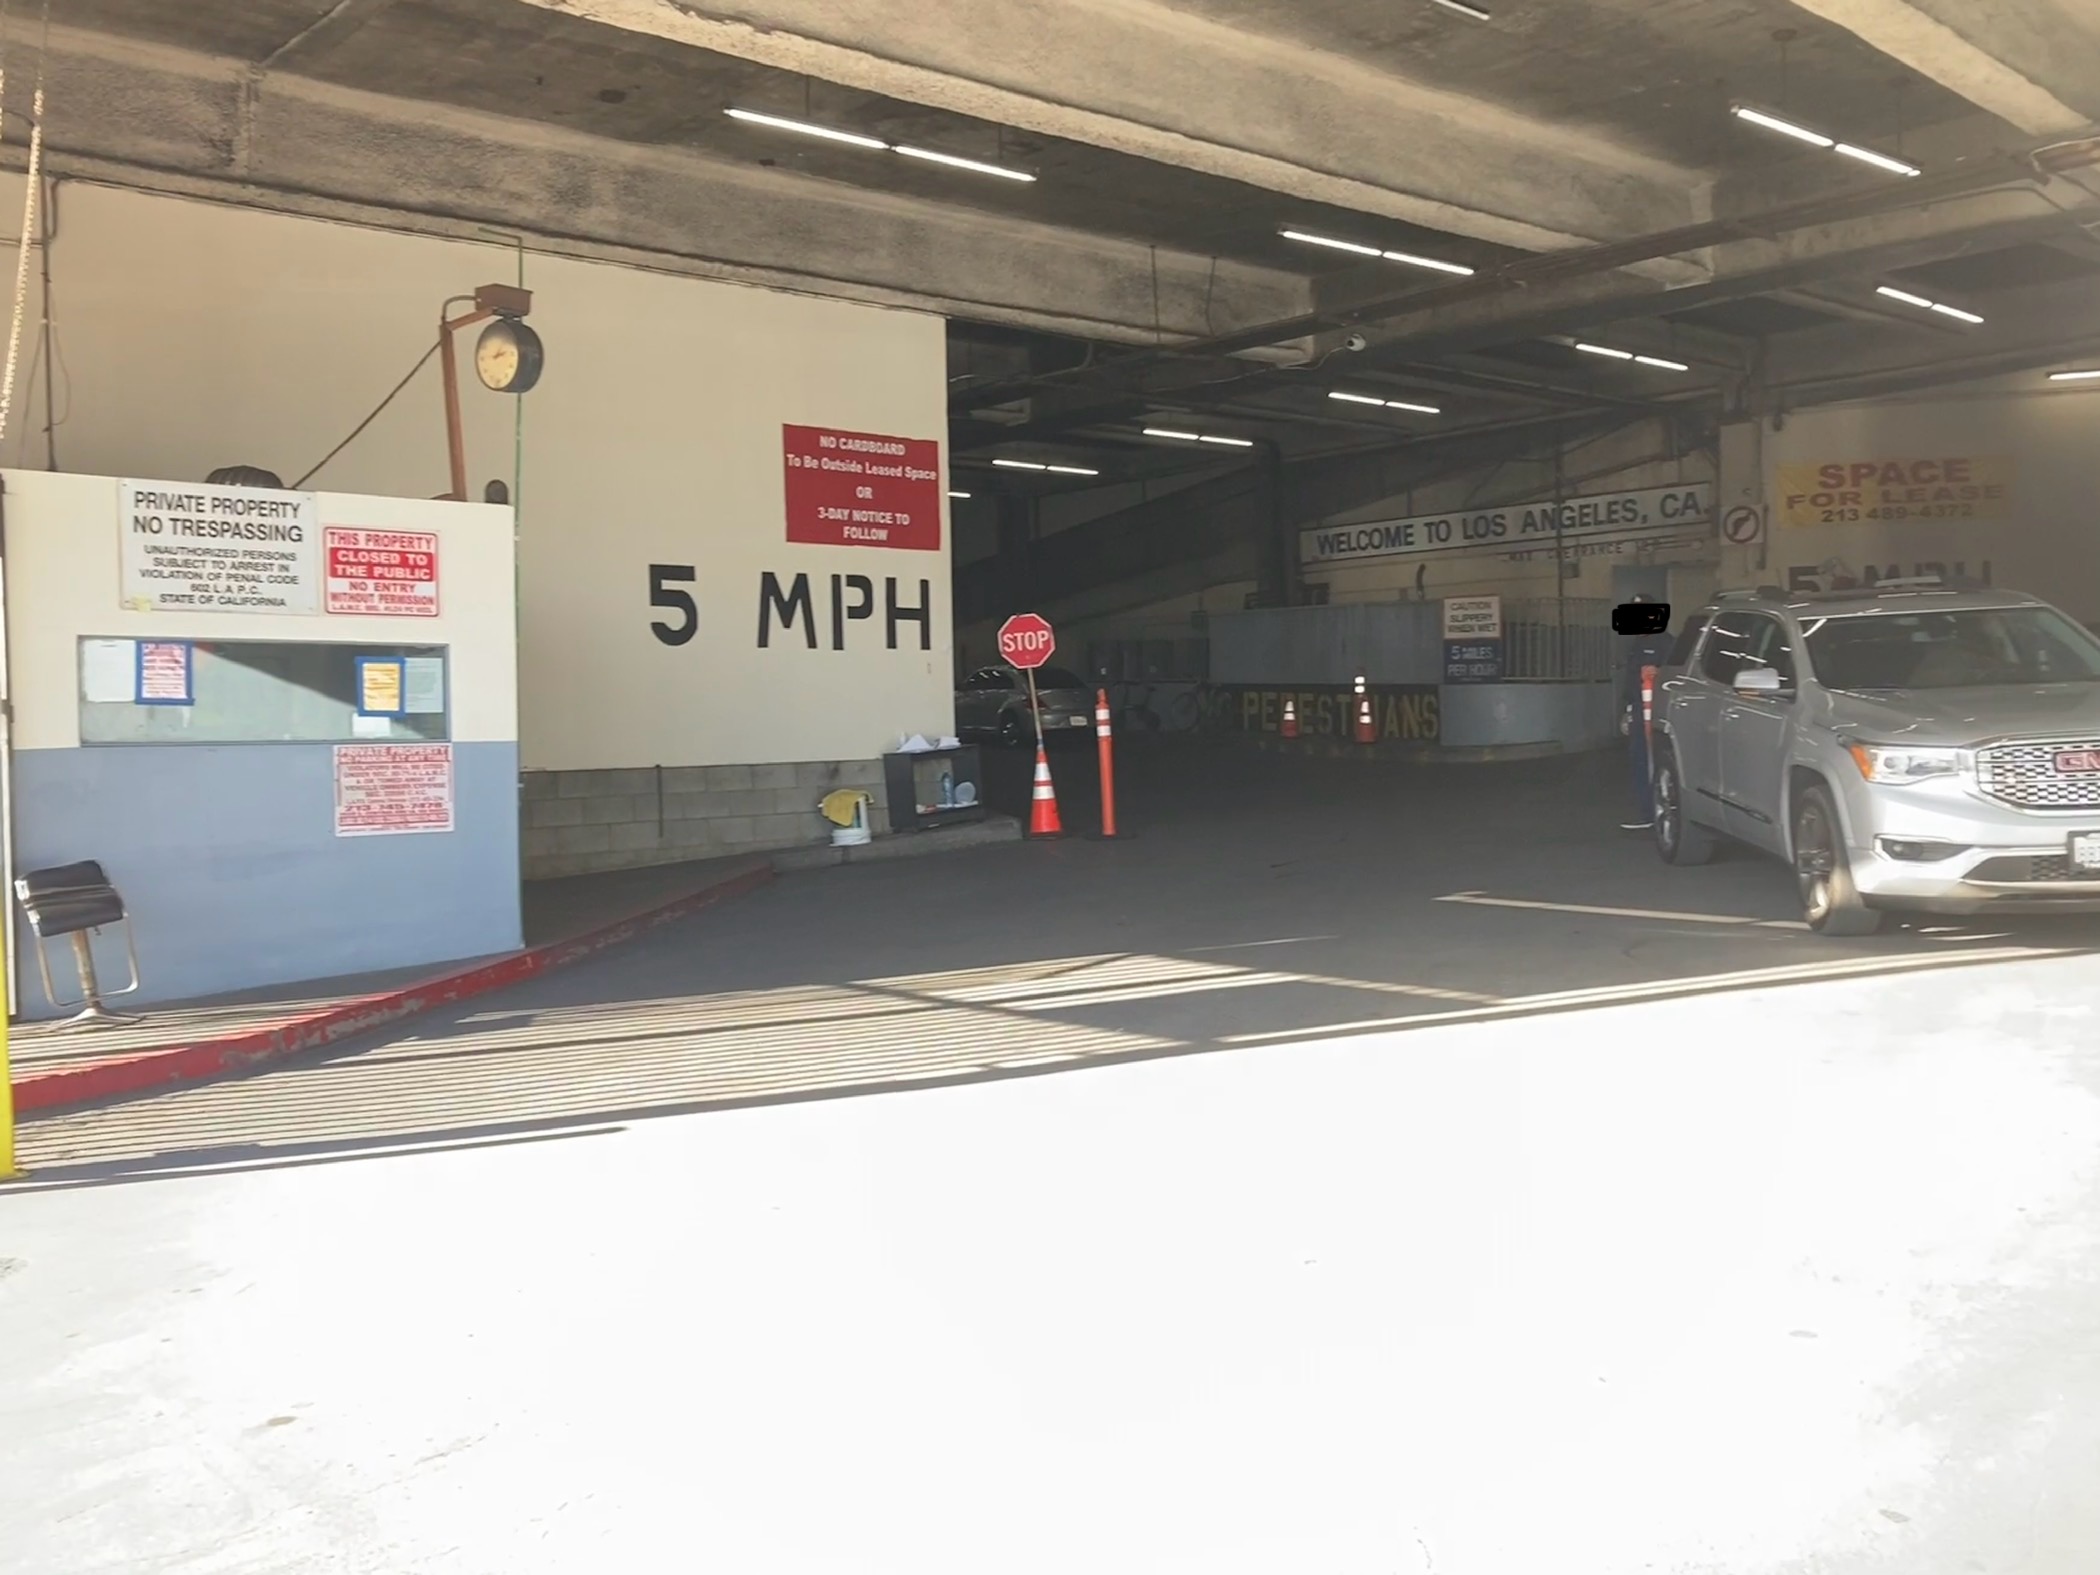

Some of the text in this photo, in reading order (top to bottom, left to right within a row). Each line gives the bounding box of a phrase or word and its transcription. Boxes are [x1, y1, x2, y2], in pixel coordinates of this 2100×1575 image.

[819, 435, 905, 457] NO CARDBOARD
[787, 453, 938, 482] To Be Outside Leased Space
[1819, 458, 1971, 490] SPACE
[855, 486, 873, 500] OR
[1786, 484, 2005, 509] FOR LEASE
[134, 491, 300, 519] PRIVATE PROPERTY
[1821, 503, 1974, 523] 213 489-4372
[817, 506, 910, 527] 3-DAY NOTICE TO
[133, 515, 303, 543] NO TRESPASSING
[843, 525, 888, 541] FOLLOW
[1316, 524, 1416, 556] WELCOME
[1424, 520, 1451, 542] TO
[1462, 513, 1507, 540] LOS
[1521, 497, 1648, 534] ANGELES,
[328, 531, 433, 550] THIS PROPERTY
[144, 545, 297, 562] UNAUTHORIZED PERSONS
[336, 549, 428, 566] CLOSED TO
[1547, 543, 1624, 560] CEARANCE
[153, 556, 290, 573] SUBJECT TO ARREST IN
[334, 563, 431, 580] THE PUBLIC
[139, 569, 300, 585] VIOLATION OF PENAL CODE
[190, 583, 211, 593] 602
[349, 581, 416, 593] NO ENTRY
[159, 593, 287, 608] STATE OF CALIFORNIA
[330, 592, 435, 606] WITHOUT PERMISSION
[648, 563, 932, 651] 5 MPH
[1002, 629, 1050, 652] STOP
[1451, 645, 1495, 660] 5 MILES
[1447, 664, 1468, 677] PER
[1242, 691, 1440, 739] PEESTIANS
